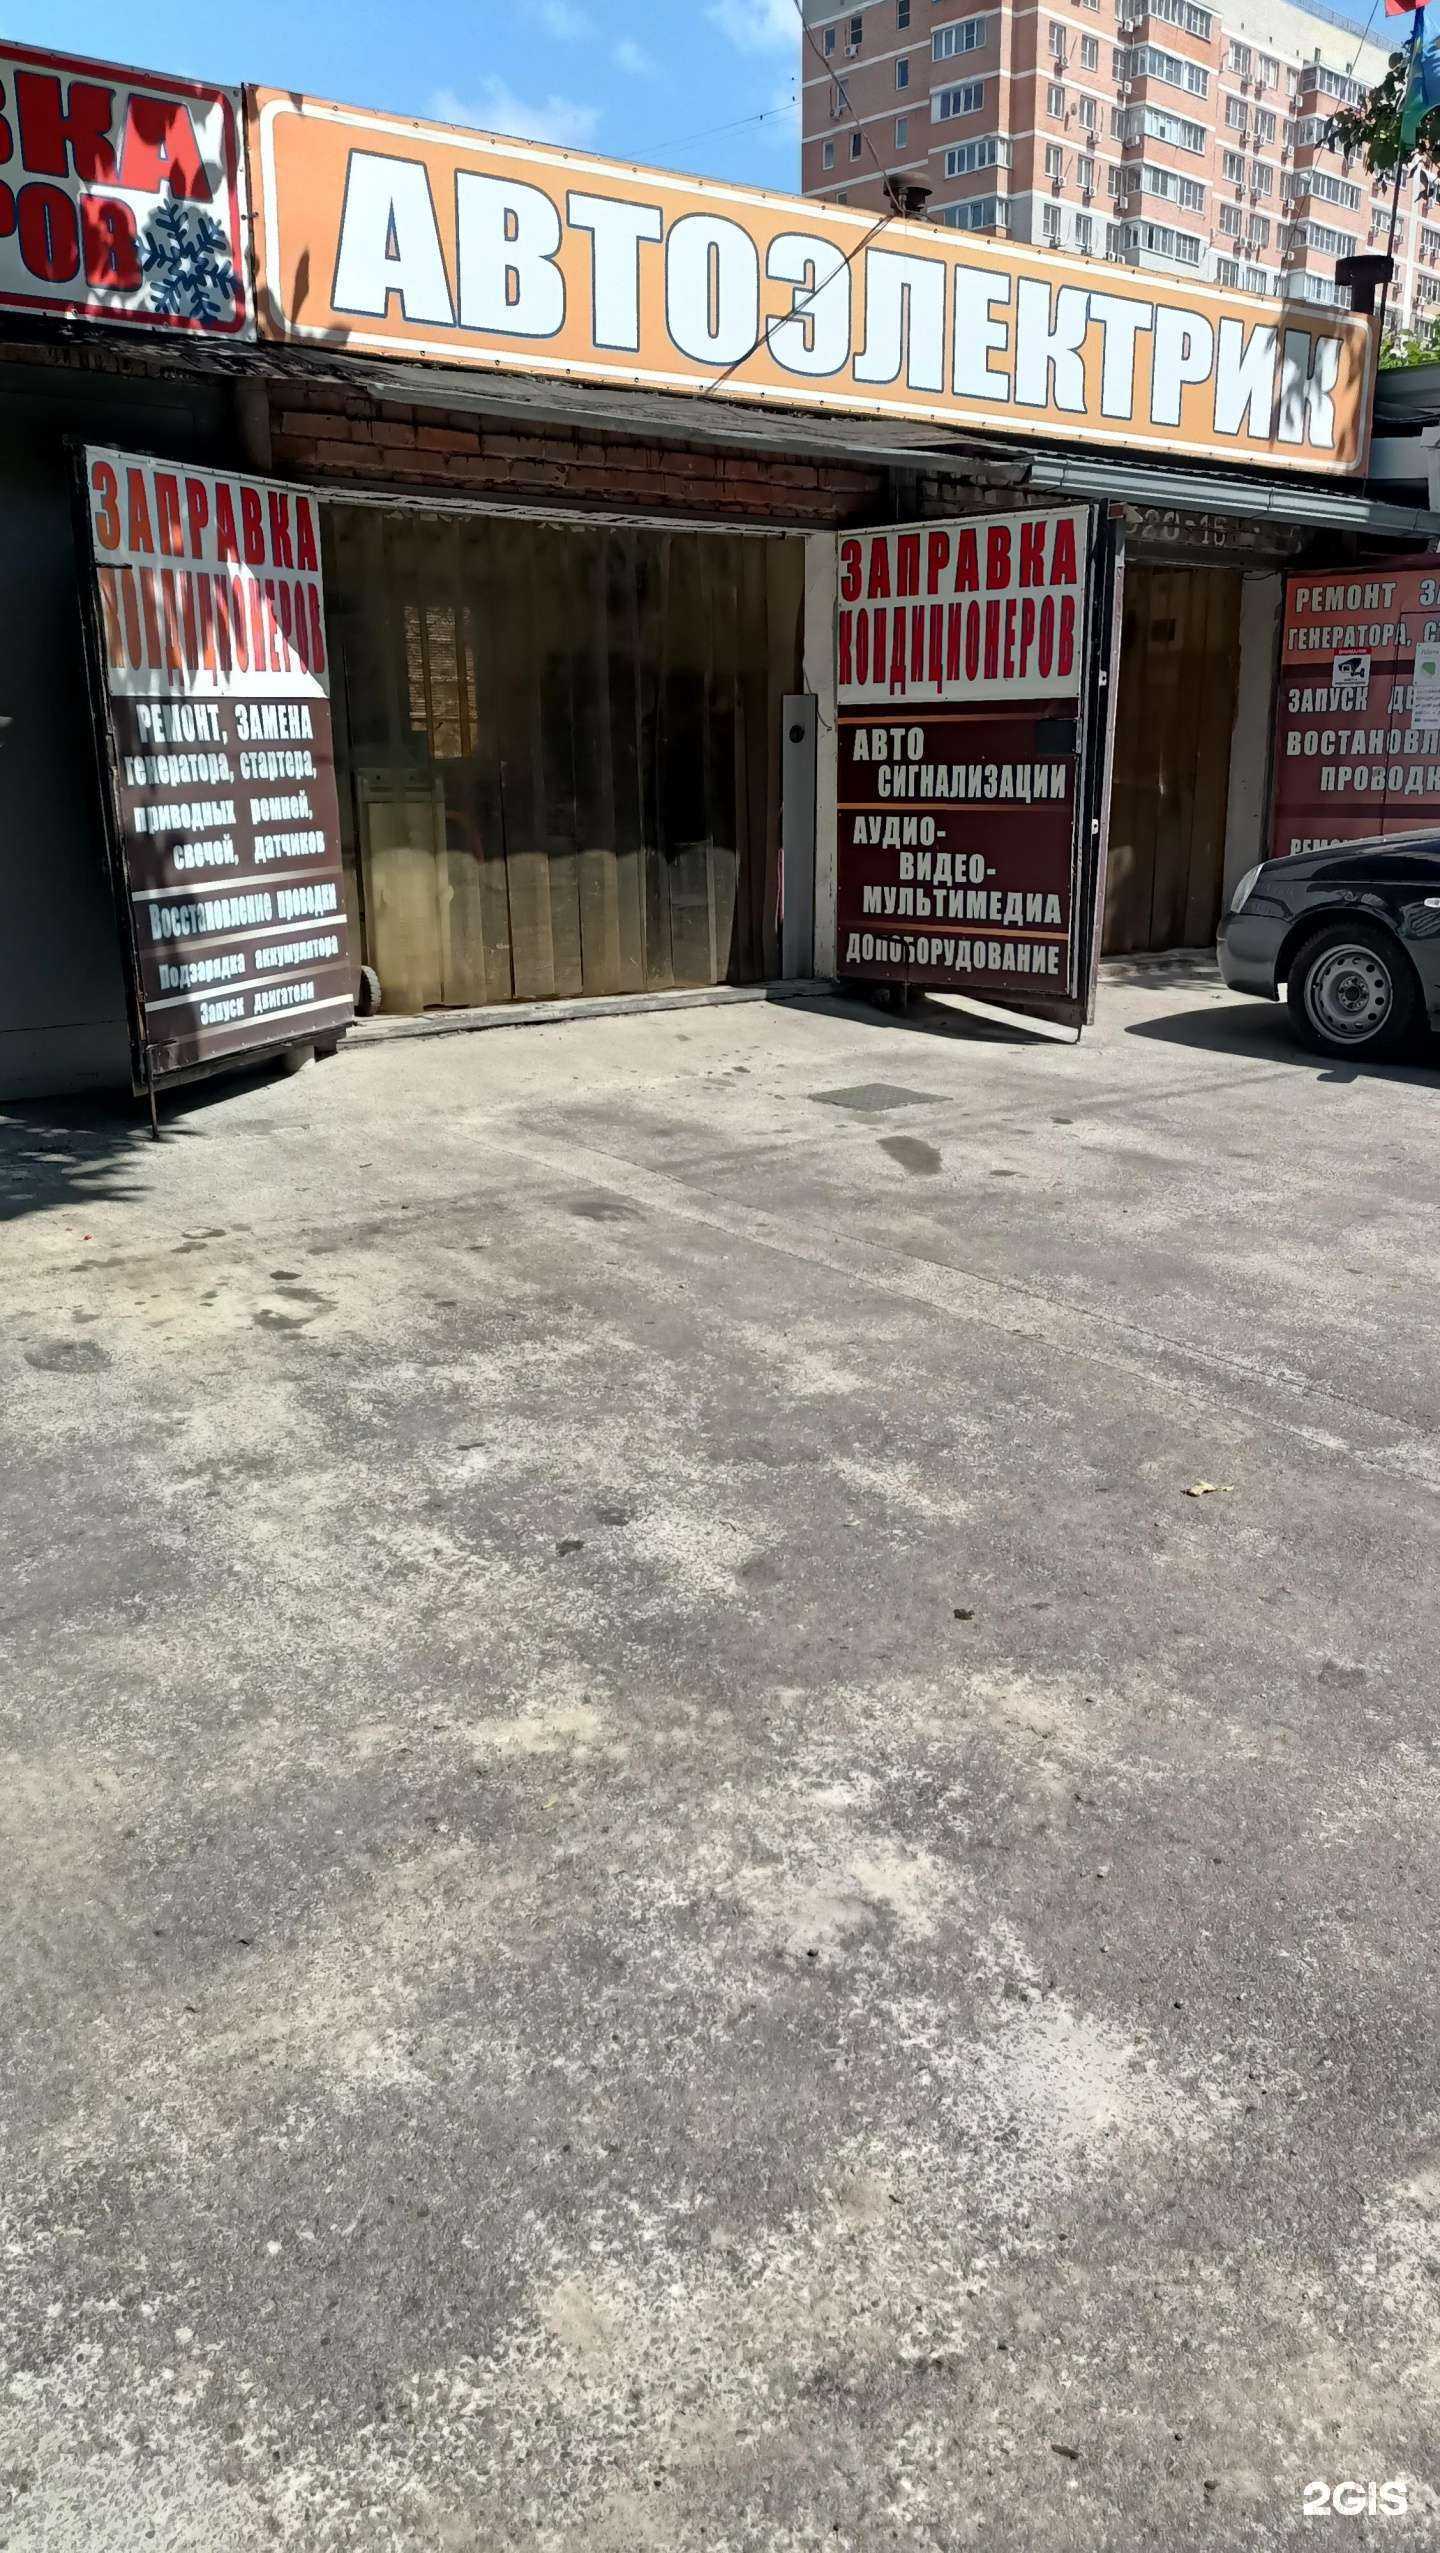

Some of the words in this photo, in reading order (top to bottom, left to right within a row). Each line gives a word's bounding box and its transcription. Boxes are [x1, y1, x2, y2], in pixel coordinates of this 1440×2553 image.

[0, 69, 213, 202] КА
[0, 181, 143, 292] ОВ
[330, 147, 1343, 450] АВТОЭЛЕКТРИК
[91, 460, 319, 572] ЗАПРАВКА
[840, 517, 1078, 602] ЗАПРАВКА
[1295, 582, 1398, 613] РЕМОНТ
[98, 566, 326, 687] КОНДИЦИОНЕРОВ
[838, 594, 1075, 696] КОНДИЦИОНЕРОВ
[1288, 622, 1412, 651] ГЕНЕРАТОРА,
[1288, 686, 1369, 714] ЗАПУСК
[136, 703, 228, 745] РЕМОНТ,
[235, 703, 314, 741] ЗАМЕНА
[853, 727, 925, 761] АВТО
[124, 752, 235, 787] генератора,
[239, 750, 317, 781] стартера,
[877, 764, 1066, 804] СИГНАЛИЗАЦИИ
[133, 799, 237, 835] приводных
[249, 789, 313, 825] ремней,
[853, 815, 947, 849] АУДИО-
[173, 833, 239, 870] свечей,
[899, 852, 996, 886] ВИДЕО-
[149, 891, 273, 940] Восстановление
[276, 883, 338, 920] проводки
[863, 885, 1062, 926] МУЛЬТИМЕДИА
[158, 952, 246, 990] Подзарядка
[254, 935, 339, 970] аккумулятора
[200, 996, 245, 1025] Запуск
[254, 980, 315, 1015] двигателя
